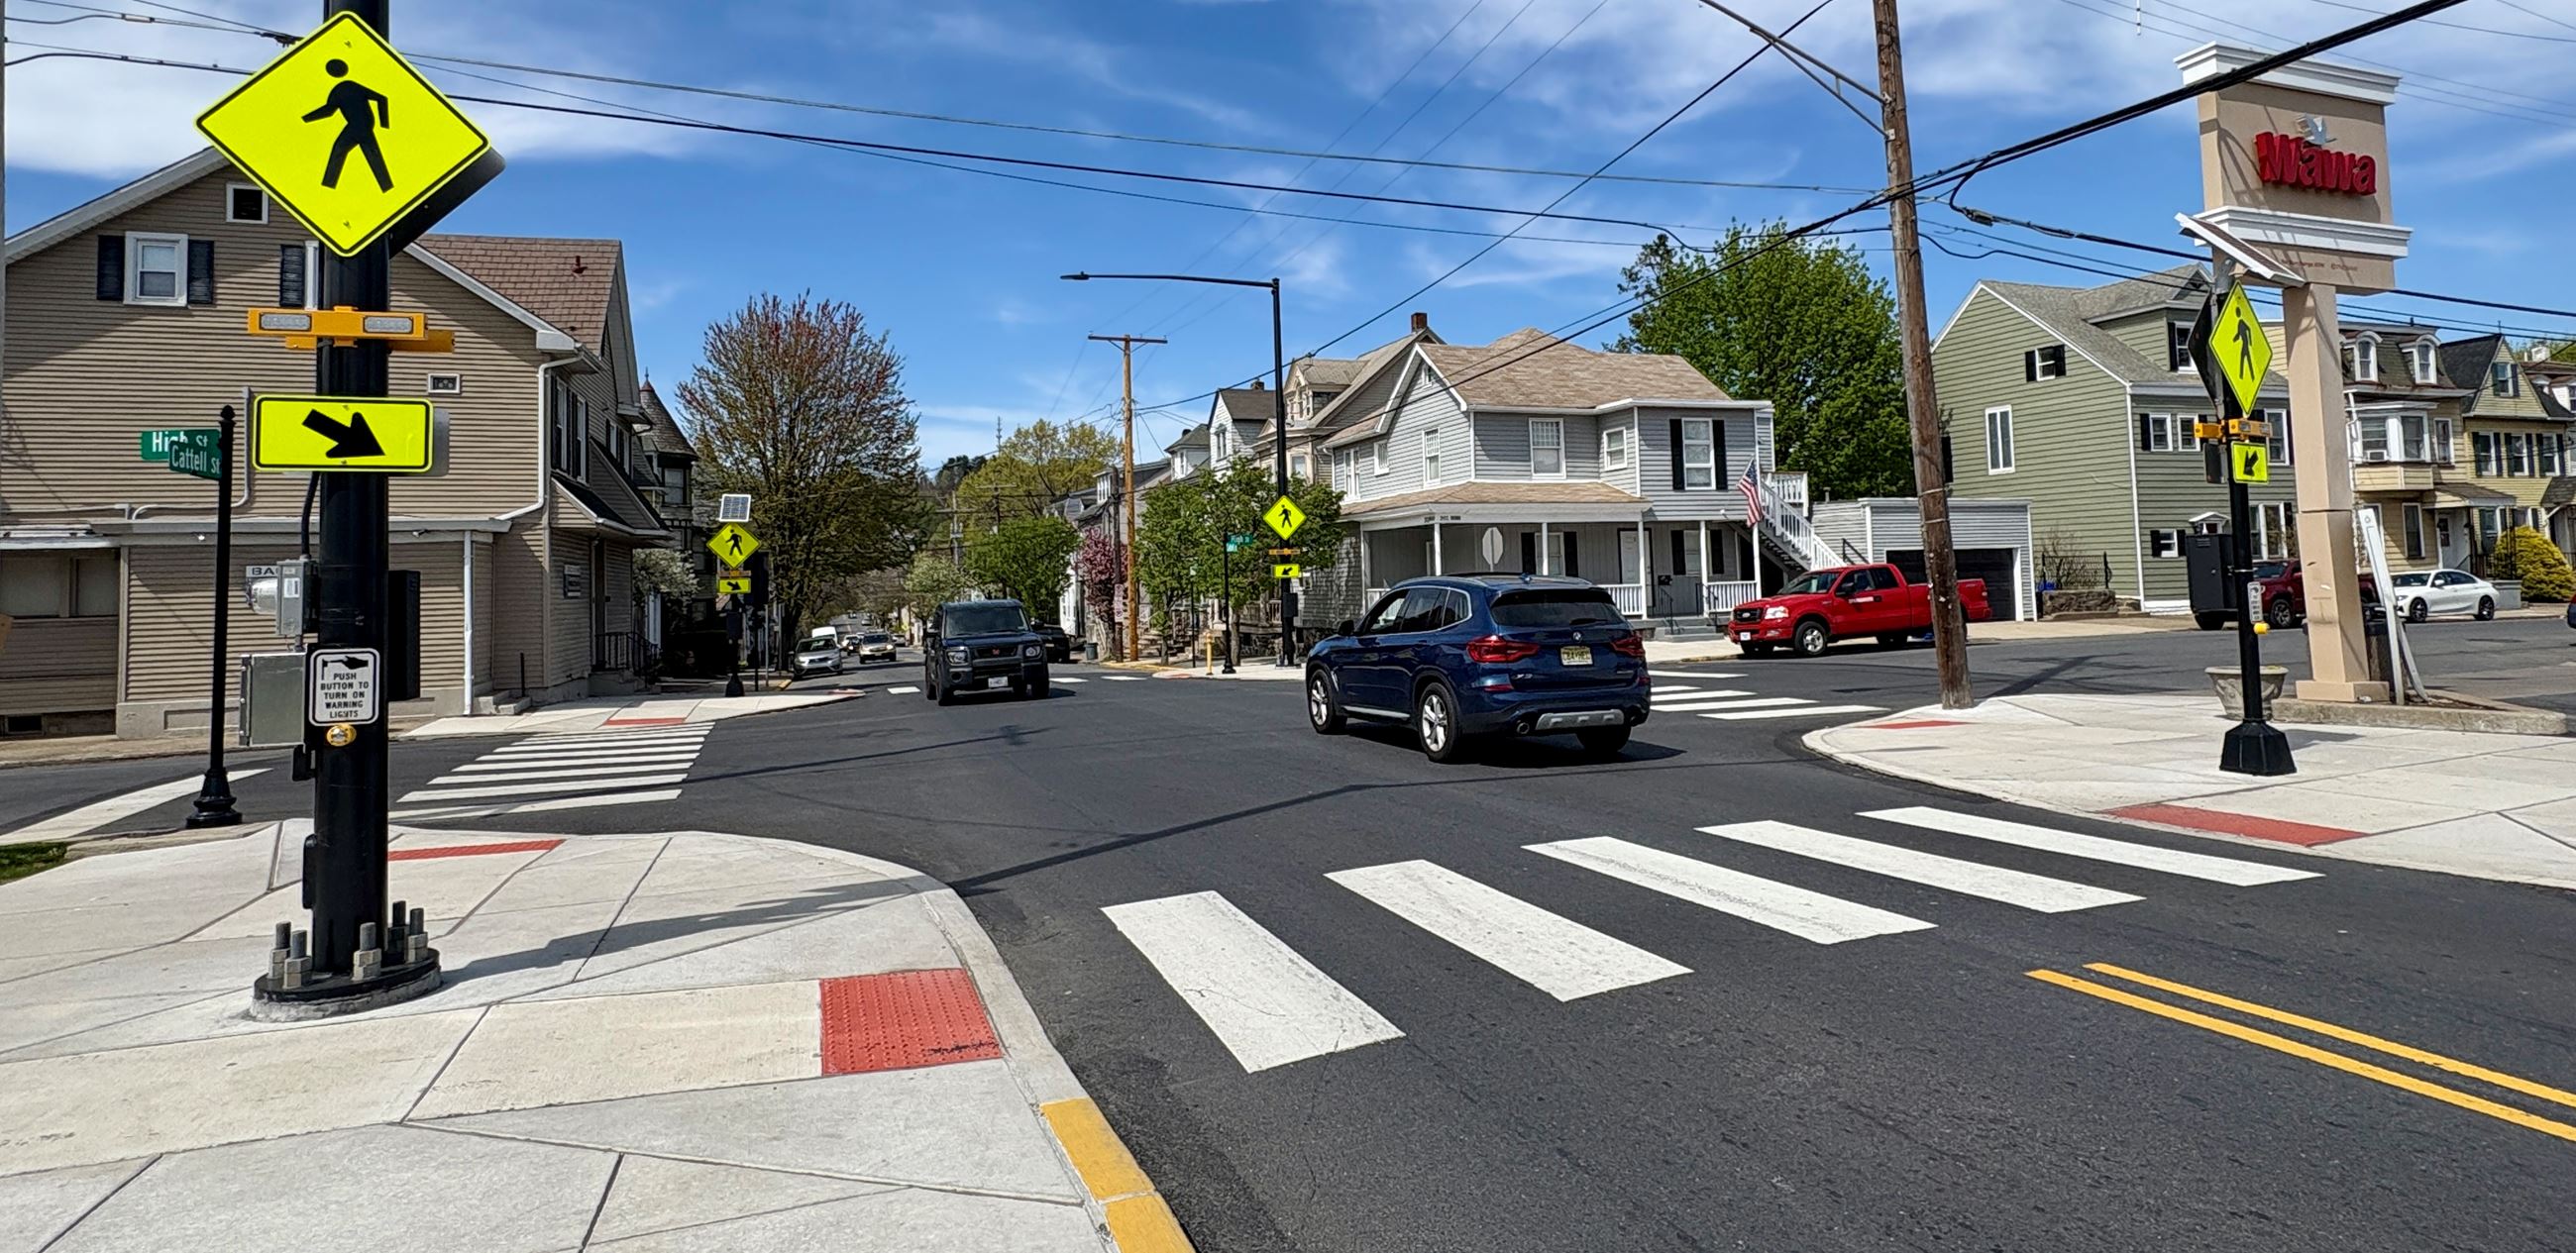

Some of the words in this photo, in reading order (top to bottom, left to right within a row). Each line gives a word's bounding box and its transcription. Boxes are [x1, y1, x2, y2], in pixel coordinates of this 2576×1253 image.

[2255, 132, 2376, 195] Wawa
[171, 445, 207, 471] Cattell
[211, 458, 220, 473] St
[252, 567, 278, 575] BA
[320, 681, 354, 690] BUTTON
[325, 700, 364, 709] WARNING
